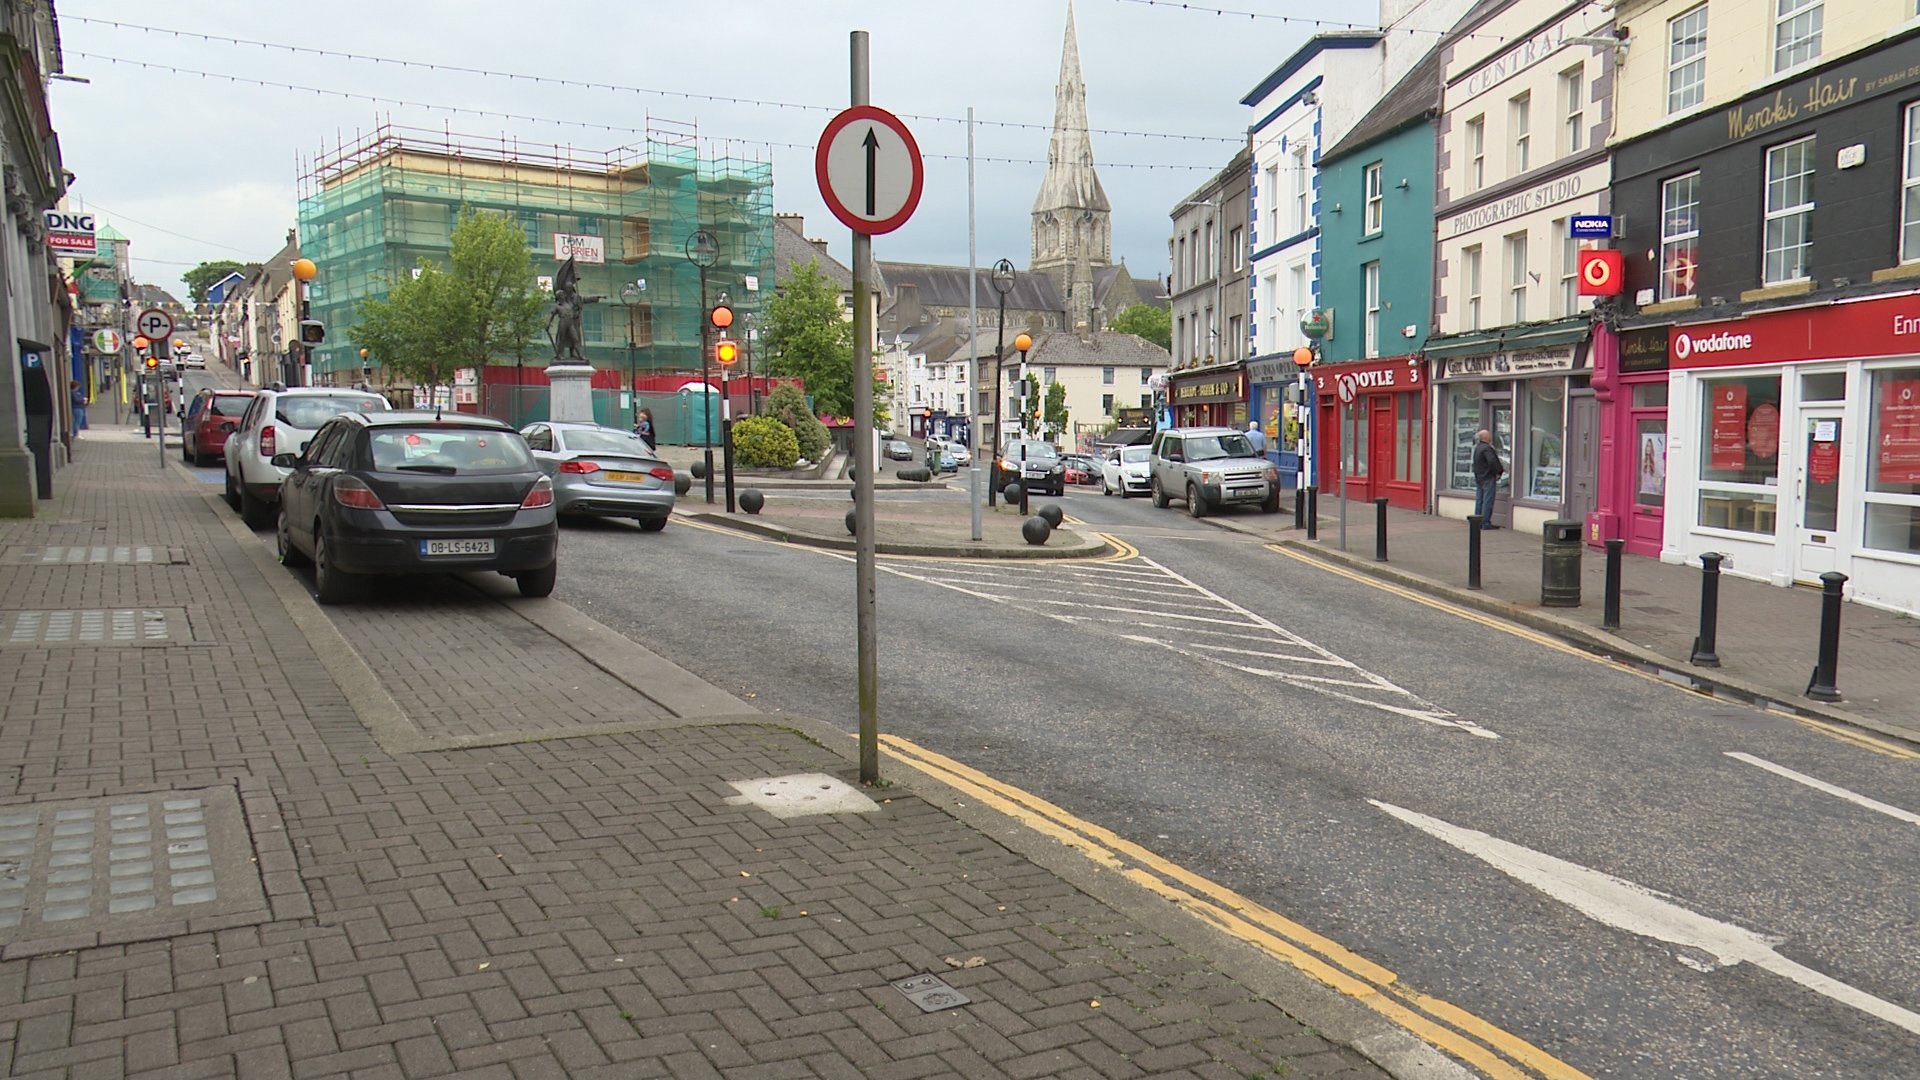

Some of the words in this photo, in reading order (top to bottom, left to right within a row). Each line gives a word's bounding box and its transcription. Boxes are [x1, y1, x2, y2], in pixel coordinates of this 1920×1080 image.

[1467, 24, 1564, 98] CENTRAL
[1865, 81, 1877, 92] BY
[1878, 70, 1906, 87] SARAH
[1728, 90, 1798, 139] Meraki
[1803, 77, 1859, 111] Hair
[1454, 193, 1532, 234] PHOTOGRAPHIC
[1535, 175, 1581, 208] STUDIO
[47, 213, 94, 231] DNG
[1575, 220, 1609, 228] NOKIA
[50, 237, 69, 245] FOR
[70, 238, 93, 247] SALE
[560, 235, 585, 247] TOM
[1692, 332, 1752, 353] vodafone
[1318, 377, 1325, 389] 3
[1410, 369, 1418, 382] 3
[431, 542, 490, 553] 08-LS-6423
